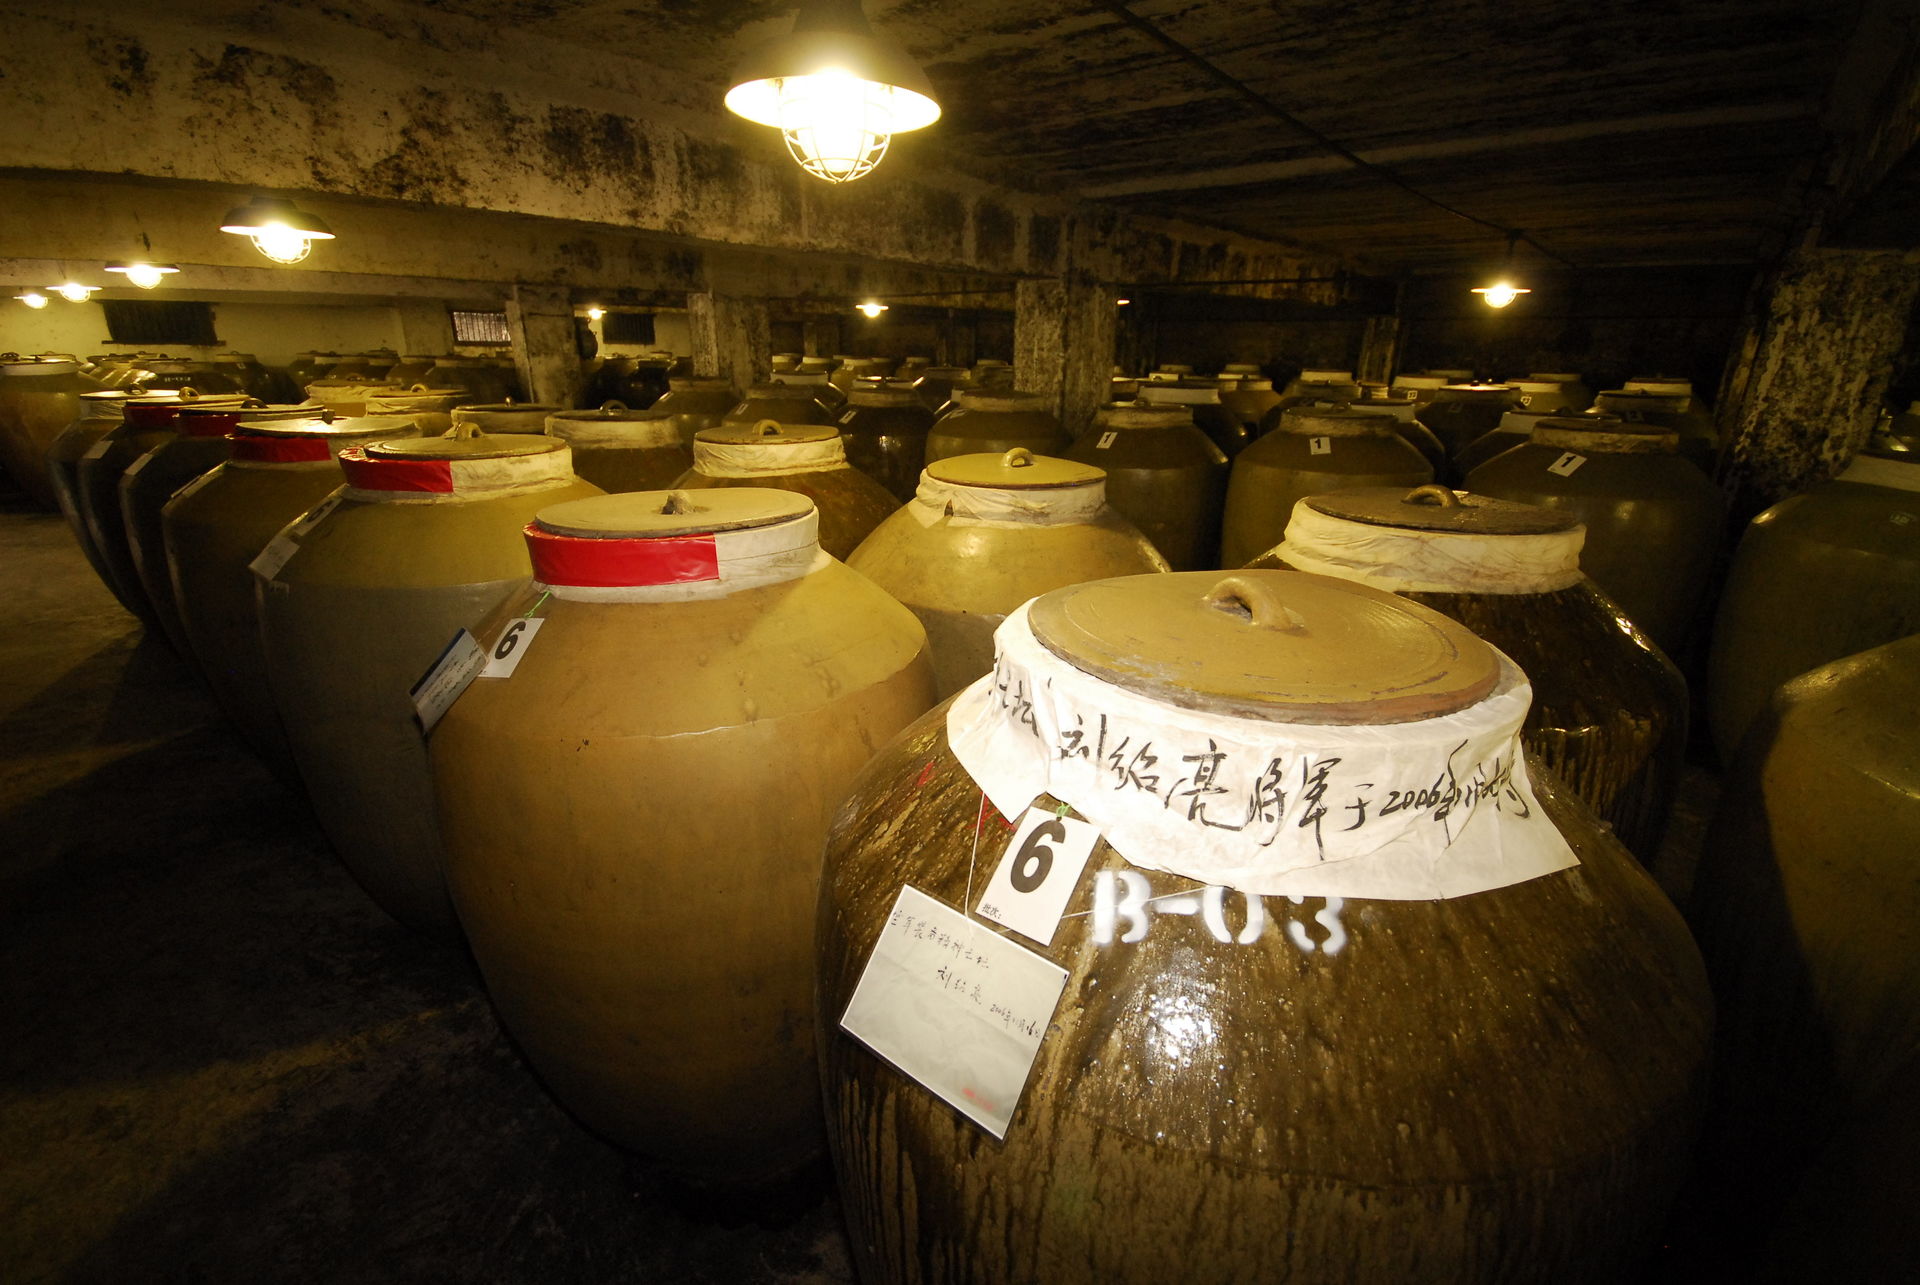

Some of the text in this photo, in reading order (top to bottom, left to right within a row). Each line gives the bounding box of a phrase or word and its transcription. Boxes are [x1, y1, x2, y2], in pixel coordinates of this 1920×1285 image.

[1314, 438, 1322, 449] 1
[1560, 455, 1576, 468] 1
[495, 621, 526, 660] 6
[1010, 820, 1066, 893] 6
[1092, 868, 1347, 956] B-03
